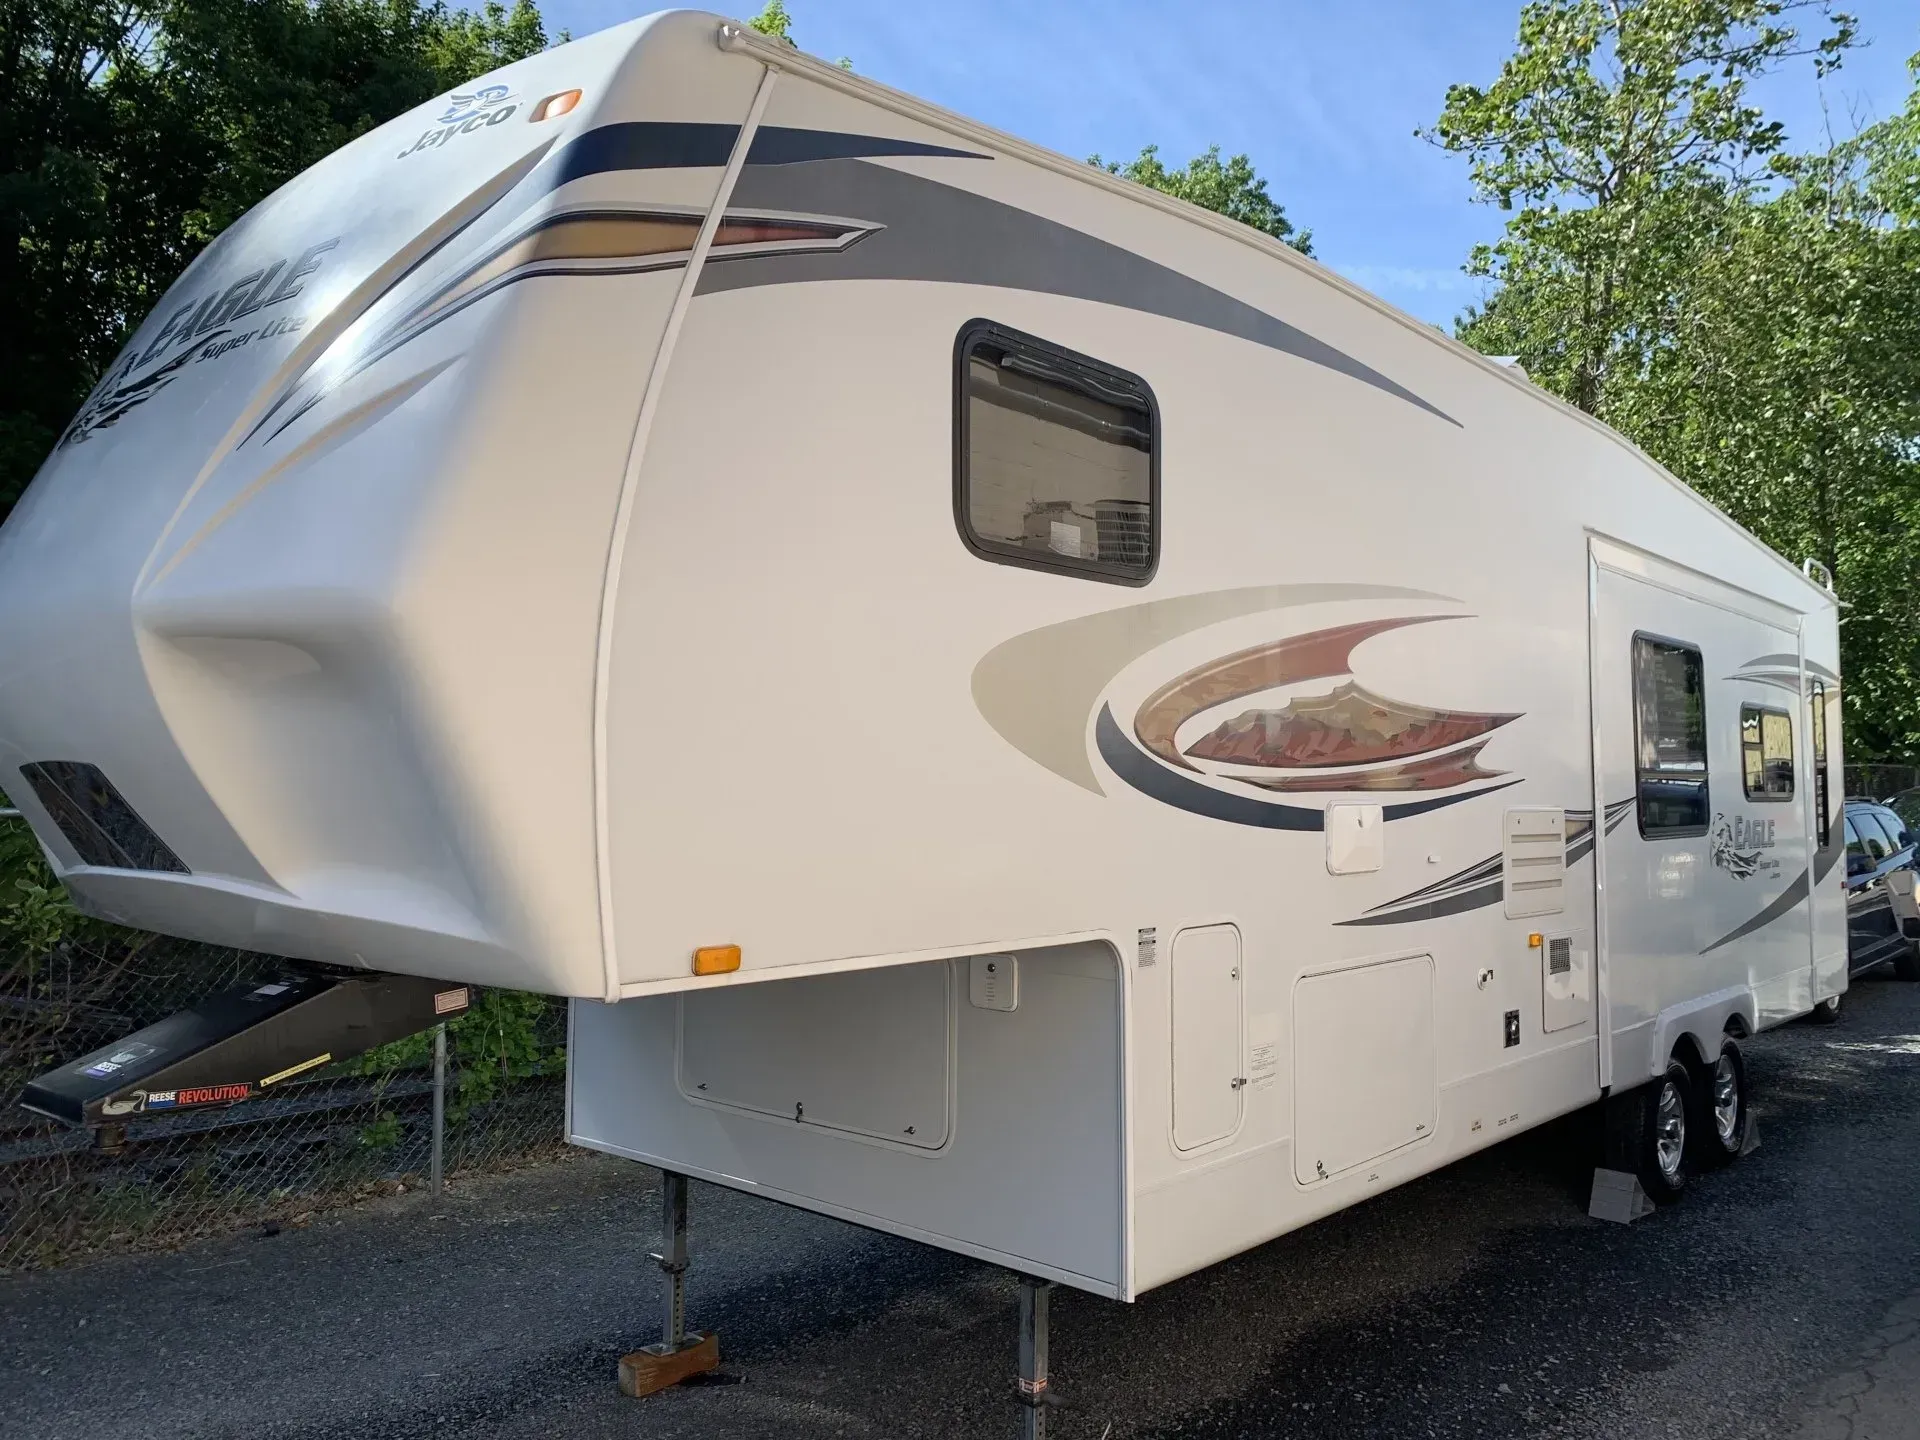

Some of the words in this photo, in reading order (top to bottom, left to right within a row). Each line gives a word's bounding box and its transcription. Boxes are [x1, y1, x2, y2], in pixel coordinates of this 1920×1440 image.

[396, 105, 517, 159] Jayco
[131, 236, 341, 372] EAGLE
[196, 328, 259, 364] Super
[257, 316, 308, 341] Lite
[1734, 815, 1775, 850] EAGLE
[149, 1091, 176, 1103] REESE
[178, 1085, 249, 1104] REVOLUTION
